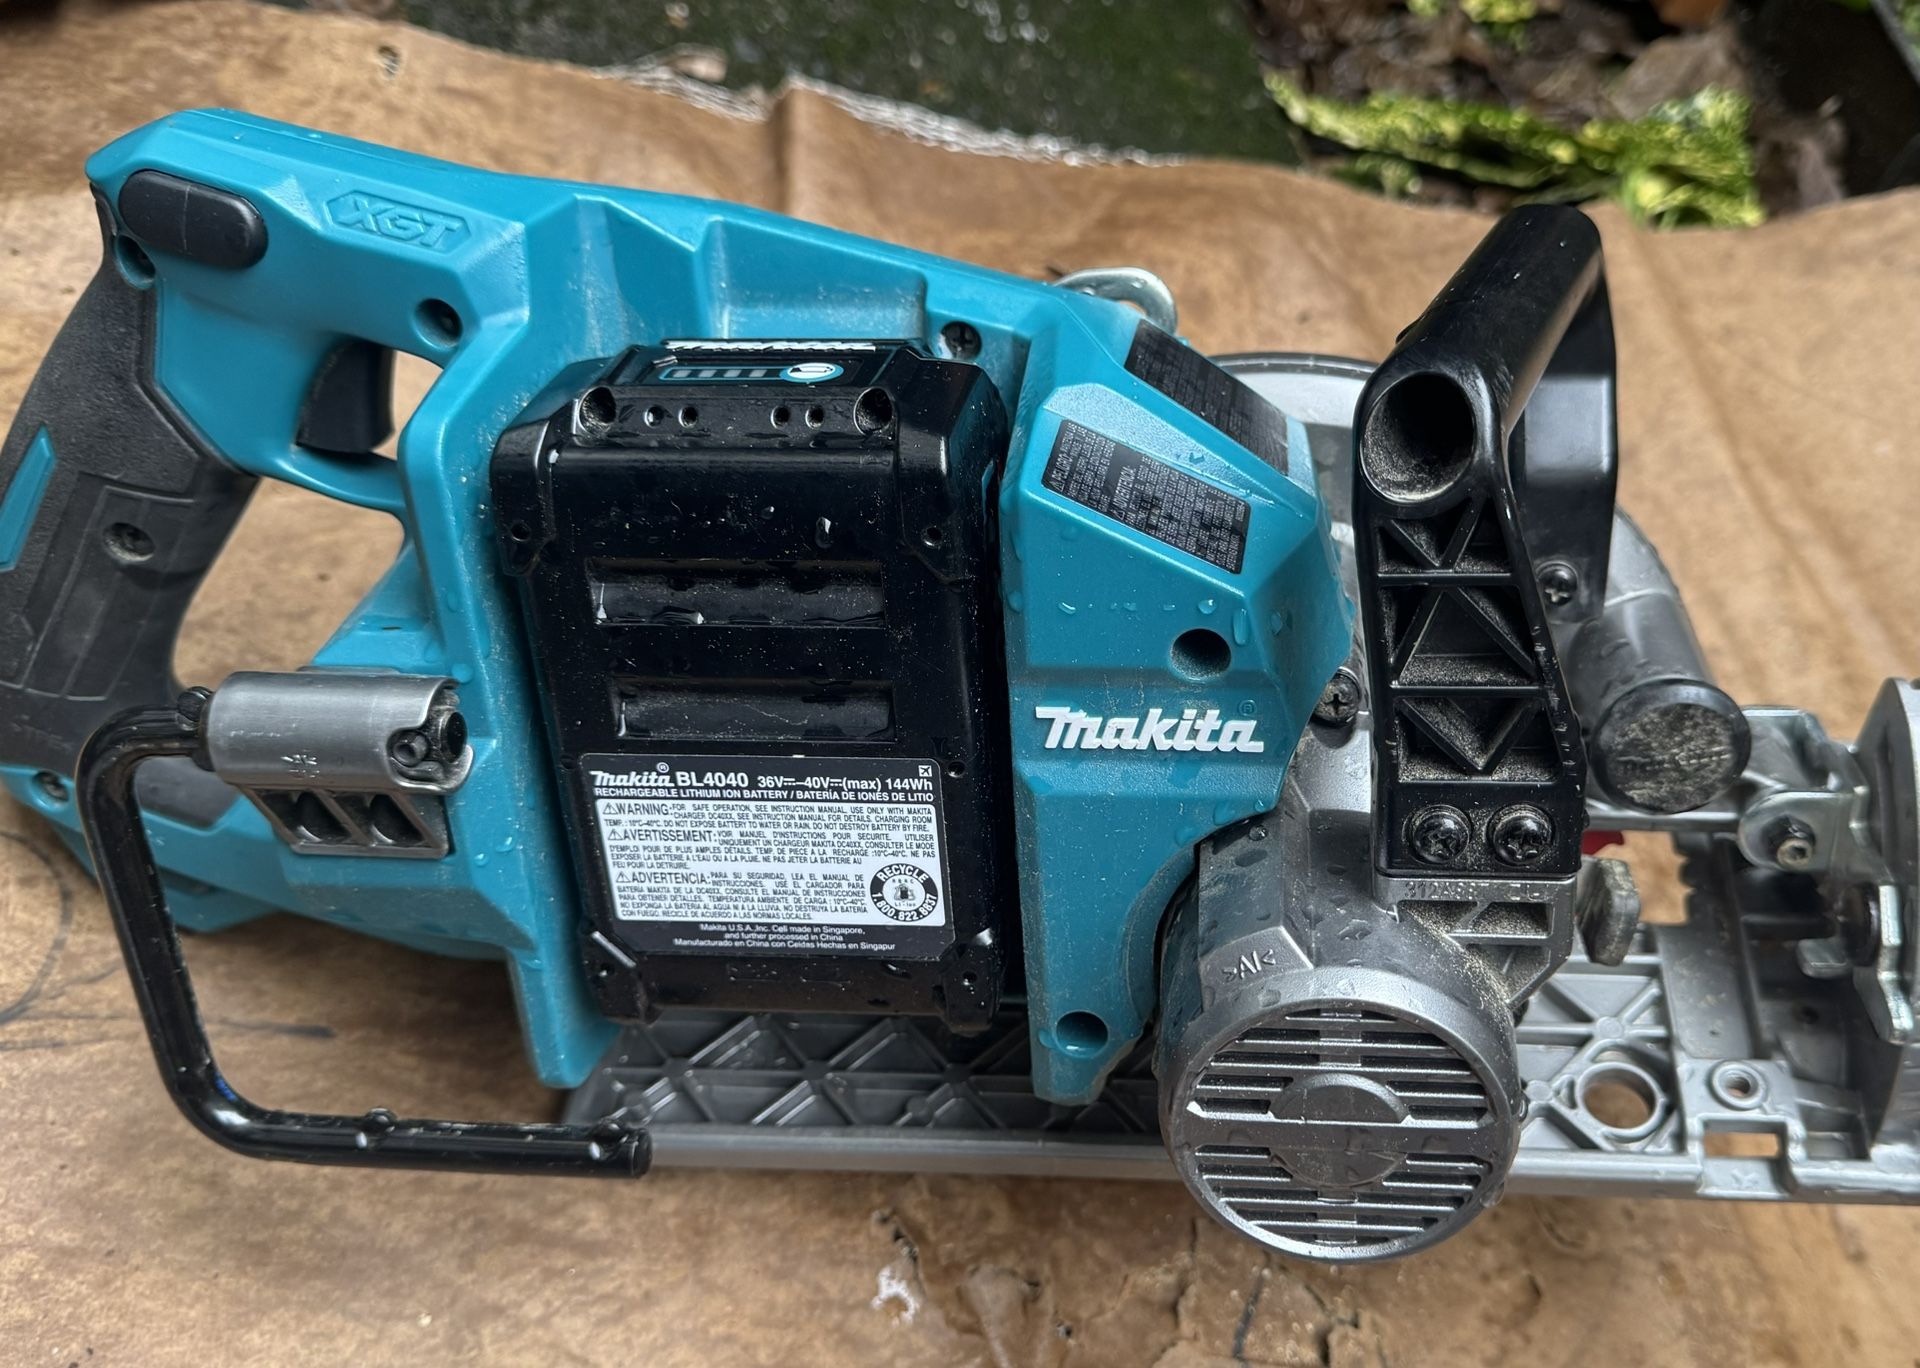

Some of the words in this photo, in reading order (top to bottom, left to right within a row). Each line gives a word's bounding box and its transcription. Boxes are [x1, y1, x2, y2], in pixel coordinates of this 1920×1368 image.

[337, 196, 463, 248] XGT
[1035, 706, 1264, 753] Makita
[589, 770, 675, 787] Makita
[675, 771, 749, 788] BL4040
[885, 778, 933, 791] 144Wh
[593, 787, 678, 798] RECHARGEABLE
[680, 788, 720, 798] LITHIUM
[722, 789, 741, 798] ION
[743, 789, 788, 799] BATTERY
[796, 788, 840, 800] BATERÍA
[841, 791, 857, 800] DE
[858, 791, 890, 801] IONES
[891, 792, 906, 801] DE
[908, 792, 934, 802] LITIO
[616, 803, 674, 816] WARNING:
[770, 805, 815, 813] INSTRUCTION
[850, 806, 864, 814] USE
[887, 807, 904, 815] WITH
[907, 807, 932, 815] MAKITA
[673, 811, 705, 820] CHARGER
[737, 812, 750, 820] SEE
[752, 813, 796, 821] INSTRUCTION
[798, 814, 826, 822] MANUAL
[828, 814, 841, 822] FOR
[875, 815, 910, 823] CHARGING
[912, 816, 932, 824] ROOM
[664, 820, 673, 828] DO
[675, 820, 688, 828] NOT
[690, 820, 716, 828] EXPOSE
[717, 821, 746, 829] BATTERY
[748, 821, 757, 829] TO
[783, 822, 792, 830] OR
[813, 822, 822, 830] DO
[840, 823, 869, 831] DESTROY
[871, 823, 900, 831] BATTERY
[902, 824, 911, 832] BY
[623, 829, 718, 842] AVERTISSEMENT:
[833, 832, 851, 840] POUR
[773, 839, 810, 847] CHARGEUR
[811, 840, 835, 848] MAKITA
[865, 841, 903, 849] CONSULTER
[916, 842, 935, 850] MODE
[631, 871, 712, 885] ADVERTENCIA:
[876, 864, 929, 883] RECYCLE
[872, 891, 937, 920] 1.800.822.8837
[741, 932, 767, 940] further
[768, 933, 809, 941] processed
[820, 933, 844, 941] China
[673, 937, 733, 946] Manufacturado
[746, 939, 770, 947] China
[816, 941, 847, 949] Hechas
[860, 941, 896, 951] Singapur
